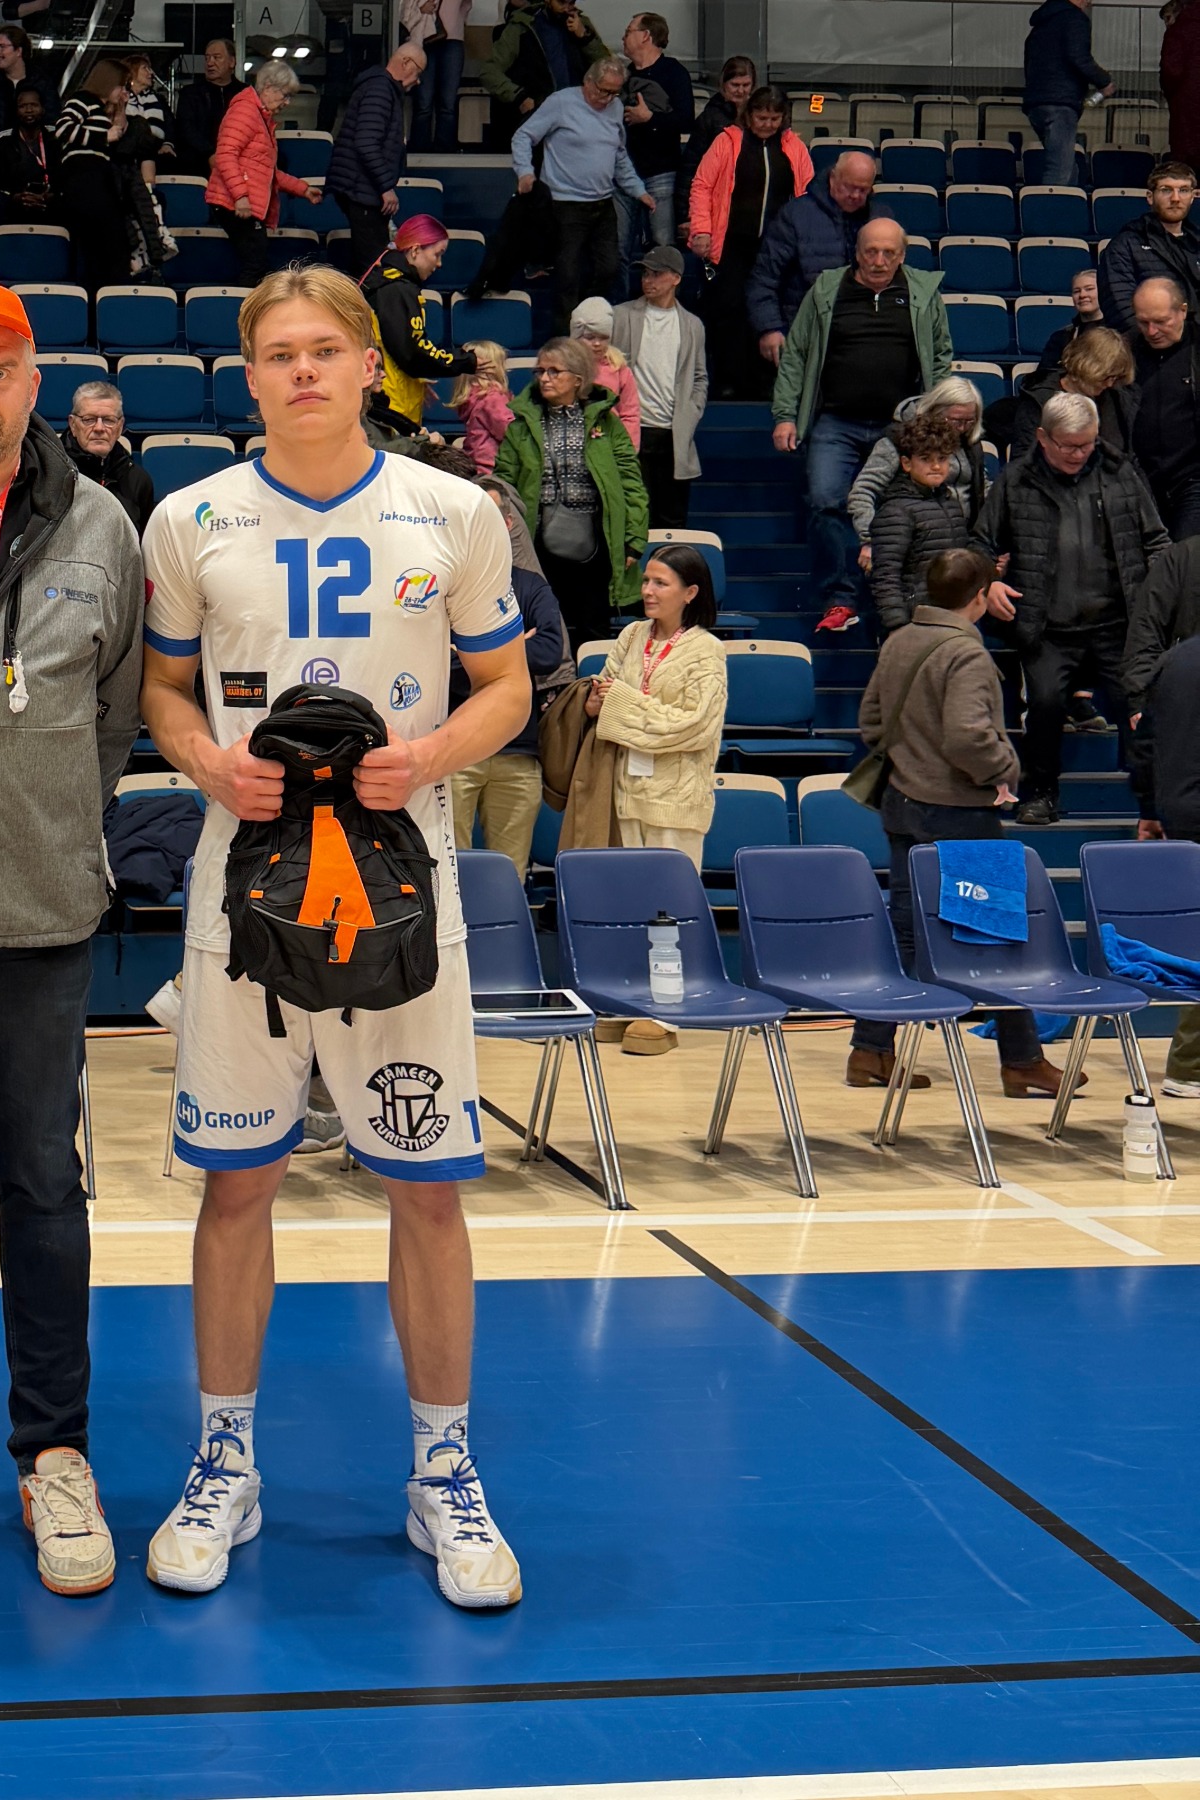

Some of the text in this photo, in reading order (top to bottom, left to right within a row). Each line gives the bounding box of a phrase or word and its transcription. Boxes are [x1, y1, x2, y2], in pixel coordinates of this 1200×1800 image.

[259, 6, 273, 25] A
[361, 9, 373, 27] B
[209, 515, 261, 532] HS-Vesi
[275, 536, 371, 639] 12
[955, 880, 974, 897] 17
[374, 1065, 438, 1088] HÄMEEN
[205, 1109, 275, 1129] GROUP
[371, 1116, 448, 1150] TURISTIAUTO
